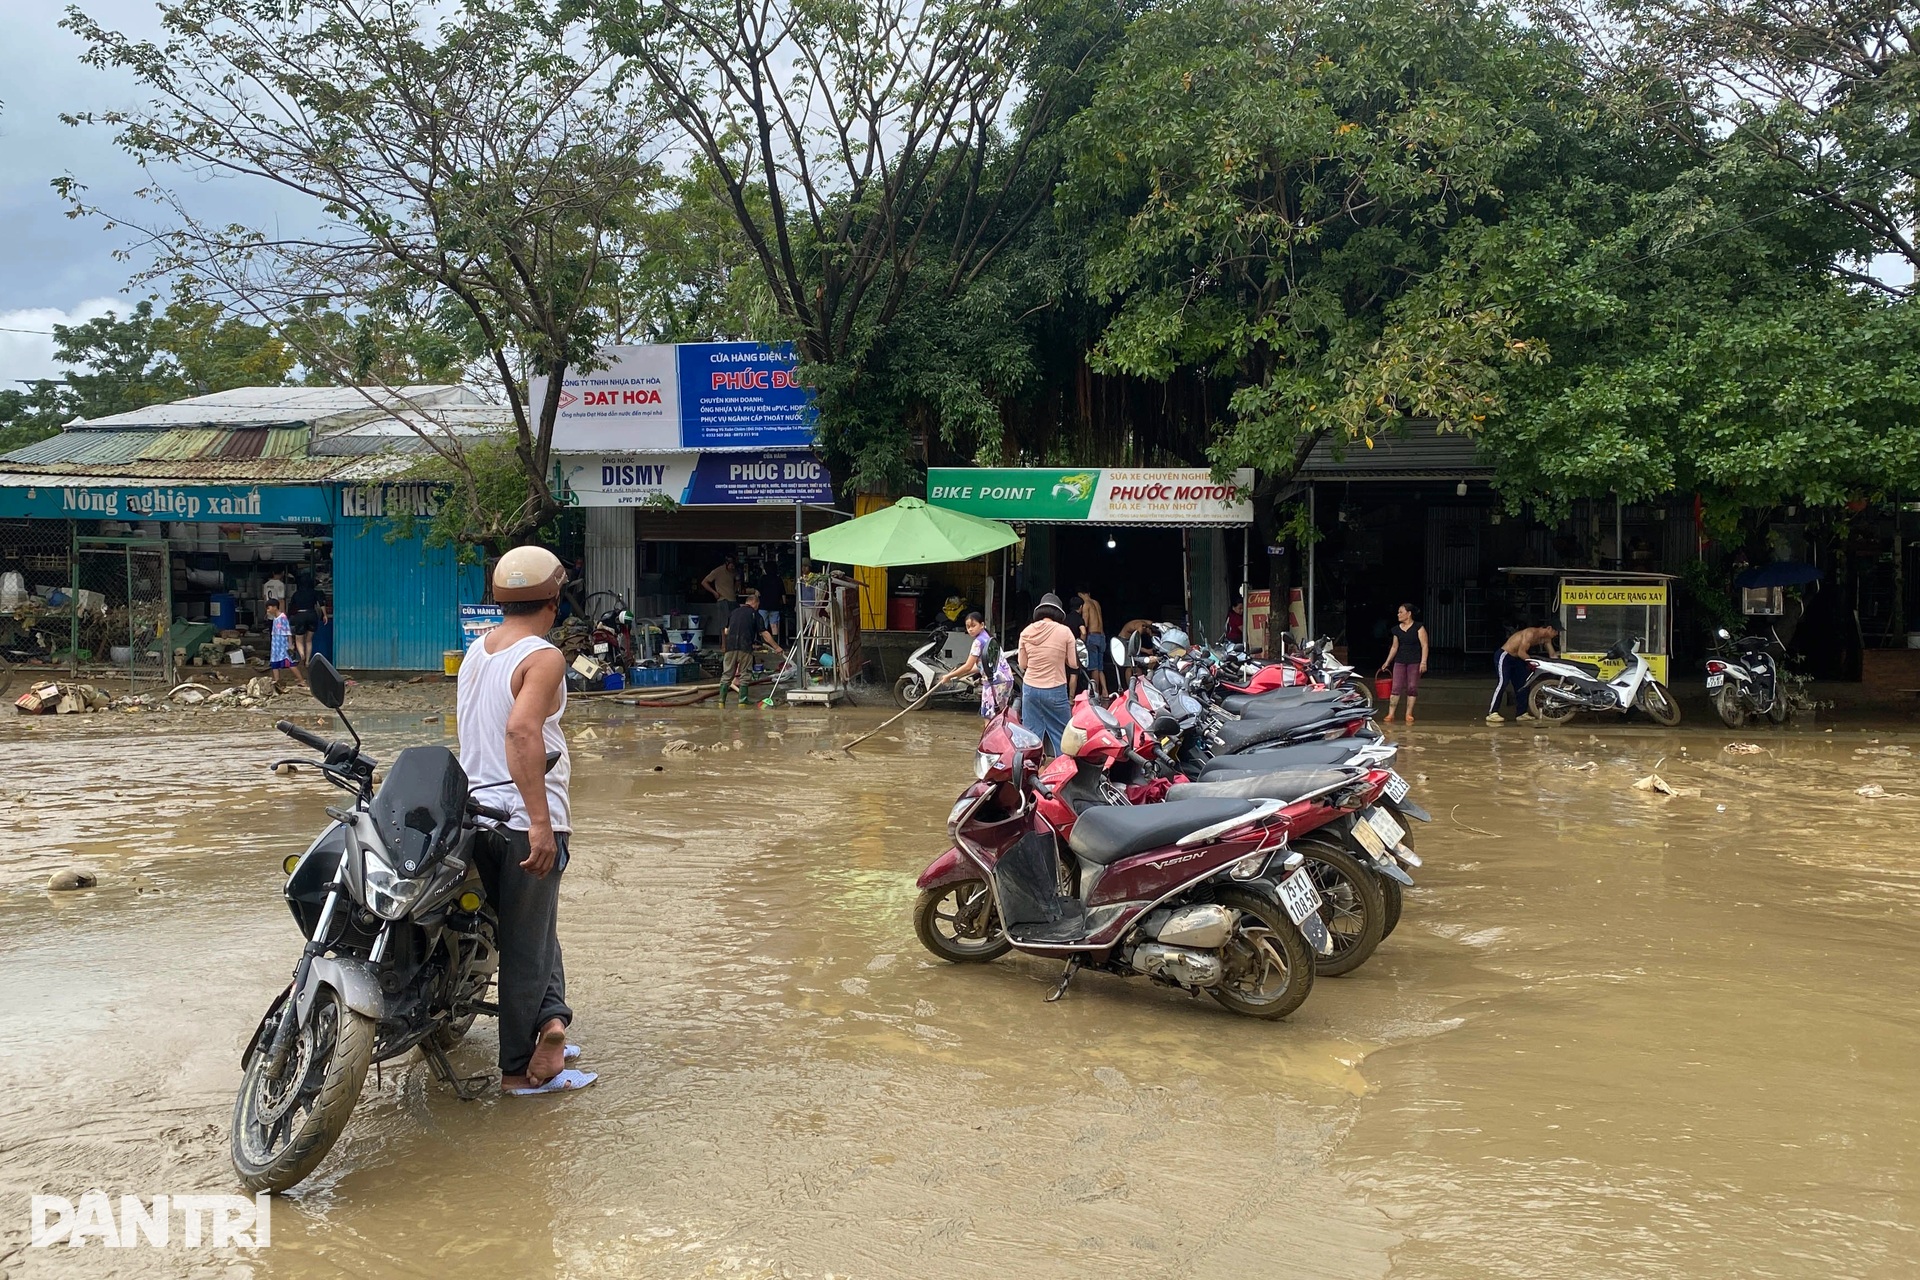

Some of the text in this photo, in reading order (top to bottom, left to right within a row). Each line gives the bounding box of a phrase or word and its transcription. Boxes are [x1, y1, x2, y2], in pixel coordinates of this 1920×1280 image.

[710, 352, 730, 363] CỬA
[731, 351, 757, 362] HÀNG
[759, 351, 781, 363] ĐIỆN
[610, 378, 629, 386] NHỰA
[646, 376, 661, 384] HÒA
[711, 367, 768, 390] PHÚC
[715, 405, 733, 414] NHỰA
[743, 405, 756, 413] PHỤ
[756, 404, 771, 413] KIỆN
[728, 414, 749, 422] NGÀNH
[750, 413, 763, 421] CẤP
[785, 413, 803, 421] NƯỚC
[602, 465, 665, 486] DISMY
[730, 460, 821, 481] PHÚC ĐỨC
[1110, 471, 1128, 480] SỬA
[1130, 472, 1141, 480] XE
[1143, 471, 1179, 480] CHUYÊN
[931, 486, 1036, 500] BIKE POINT
[1109, 482, 1237, 501] PHƯỚC MOTOR
[63, 488, 261, 518] Nông nghiệp xanh
[342, 486, 382, 517] KEM
[1109, 501, 1128, 510] RỬA
[1172, 502, 1198, 510] NHỚT
[1248, 593, 1270, 606] Chuy
[1564, 589, 1664, 603] TẠI ĐÂY CÓ CAFE RANG XAY
[462, 606, 476, 615] CỬA
[477, 607, 495, 615] HÀNG
[1145, 850, 1208, 870] VISION
[1282, 873, 1308, 902] 75-K1
[1290, 888, 1319, 921] 108.58
